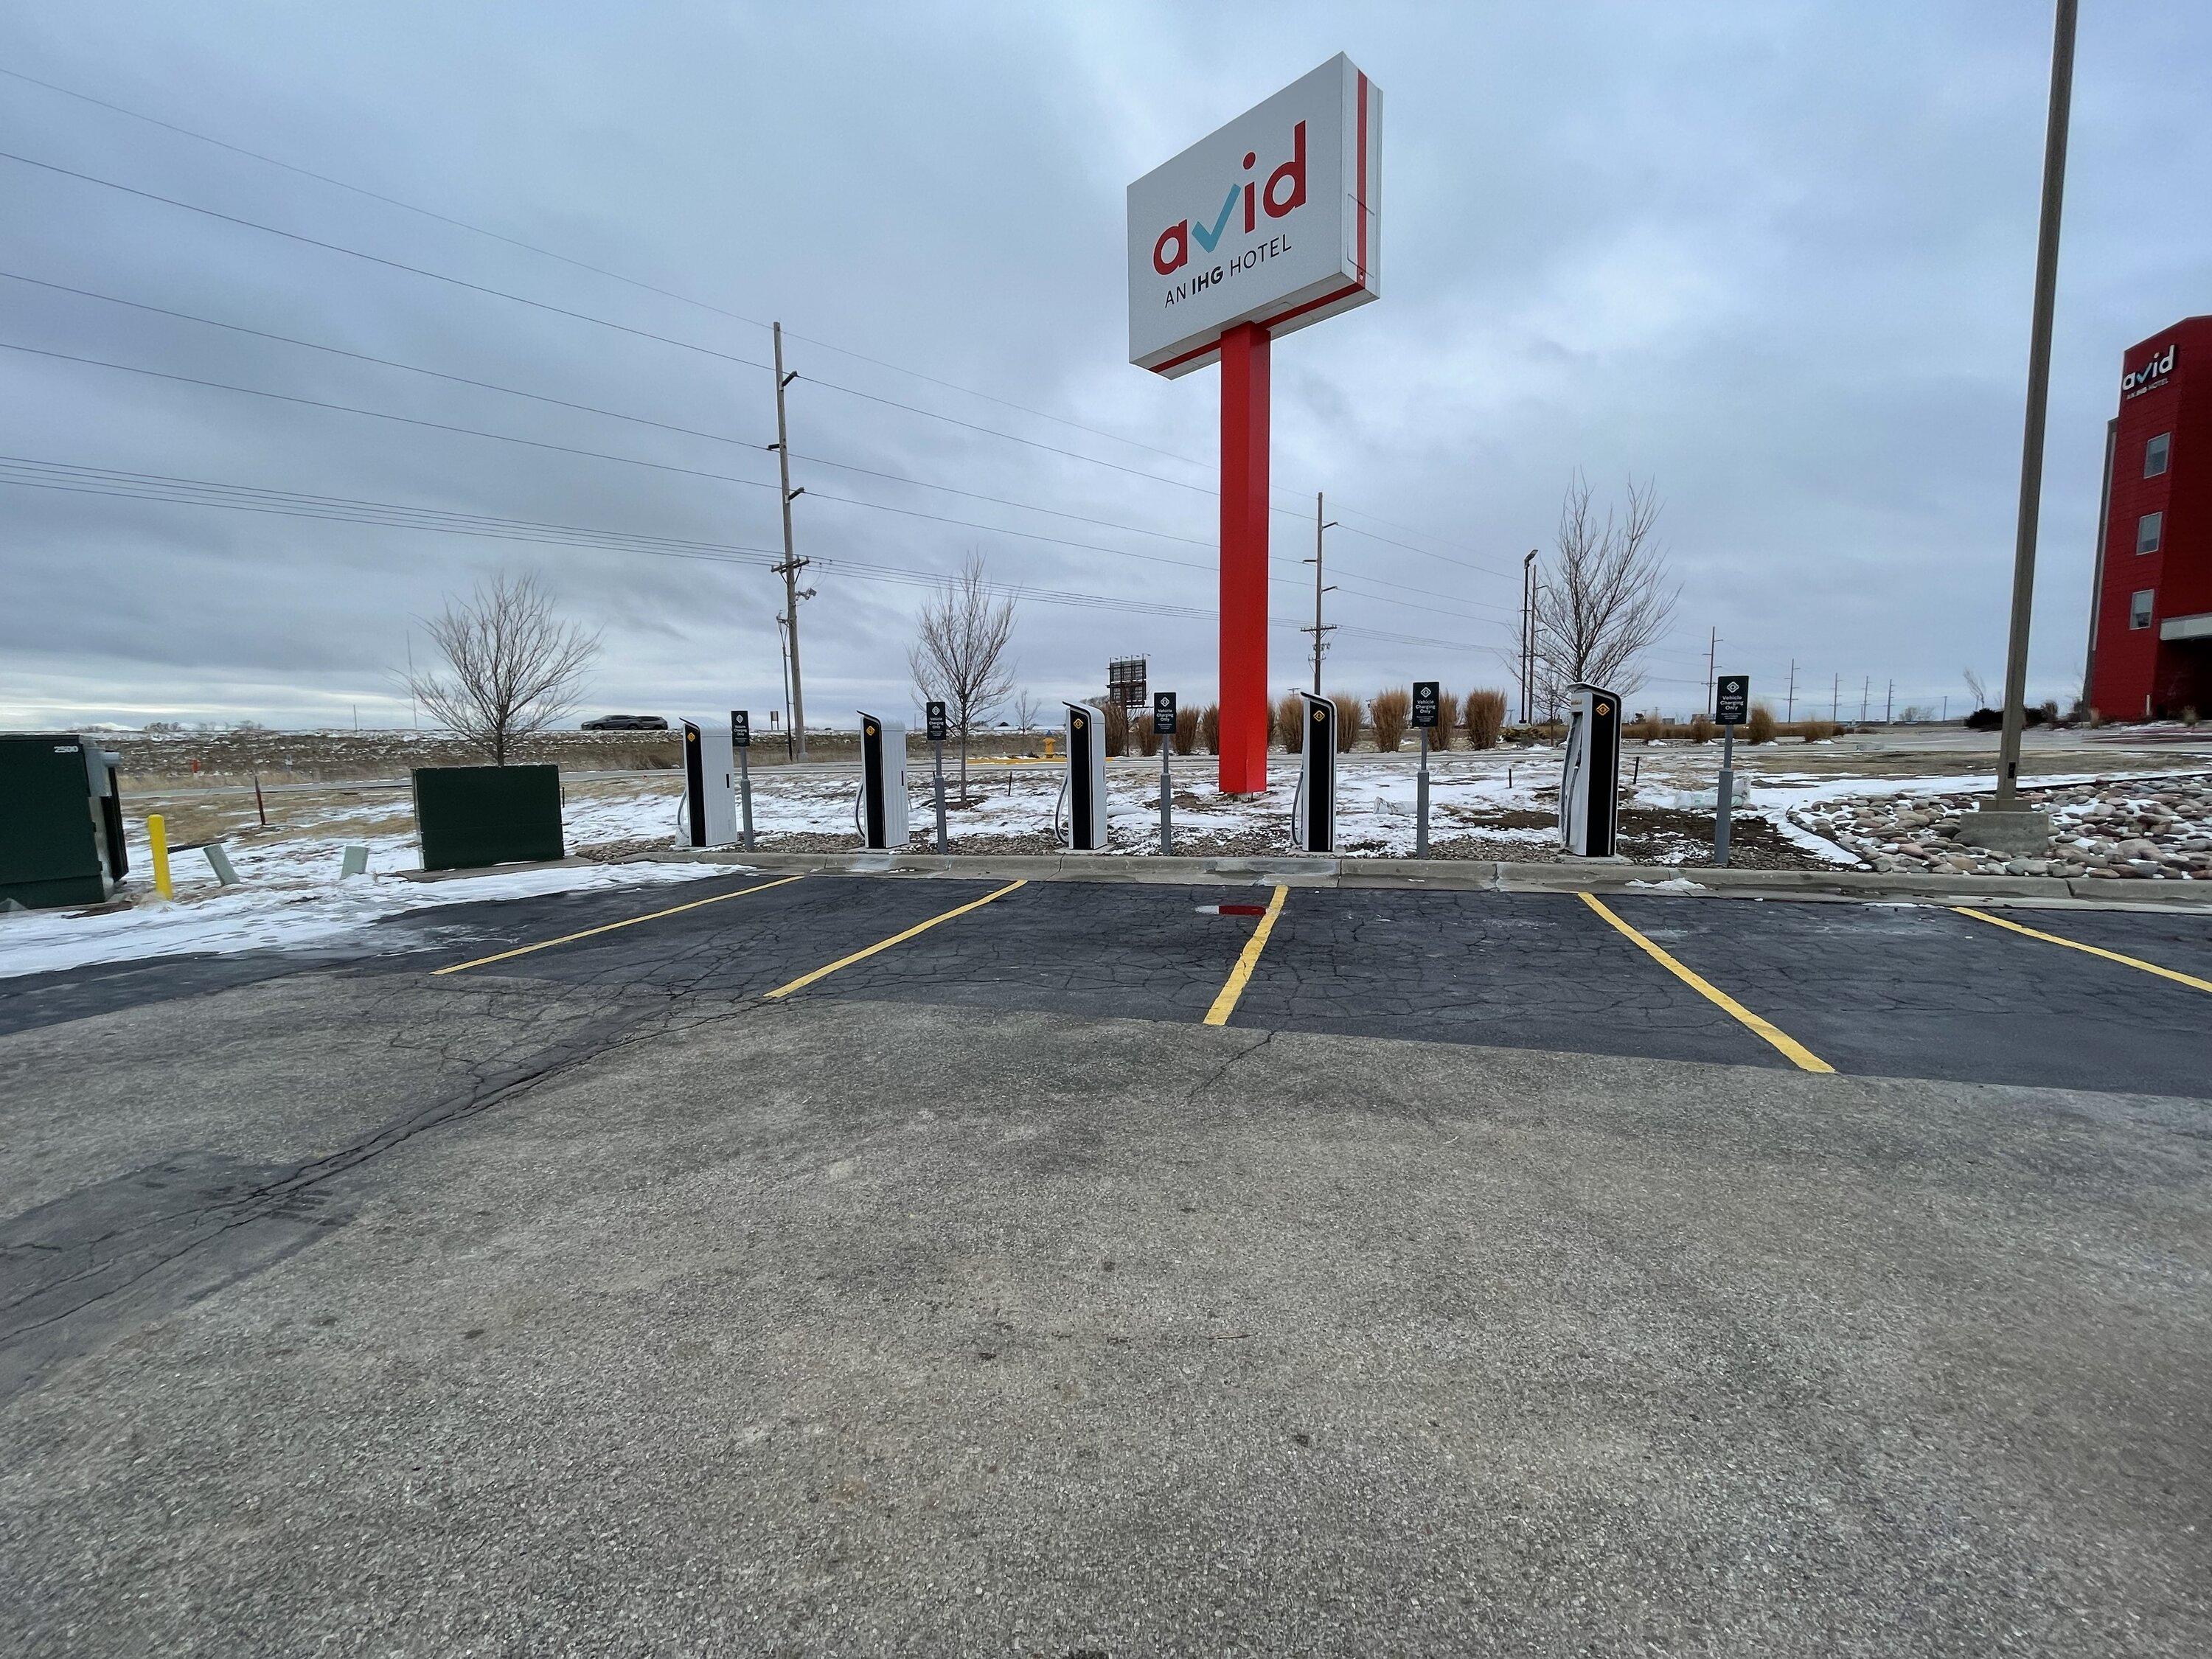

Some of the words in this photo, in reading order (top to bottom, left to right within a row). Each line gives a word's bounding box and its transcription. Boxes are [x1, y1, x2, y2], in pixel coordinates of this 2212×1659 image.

[1153, 120, 1307, 276] avid
[1164, 282, 1186, 308] AN
[1192, 265, 1224, 295] IHG
[1230, 234, 1292, 277] HOTEL
[2123, 344, 2174, 390] avid
